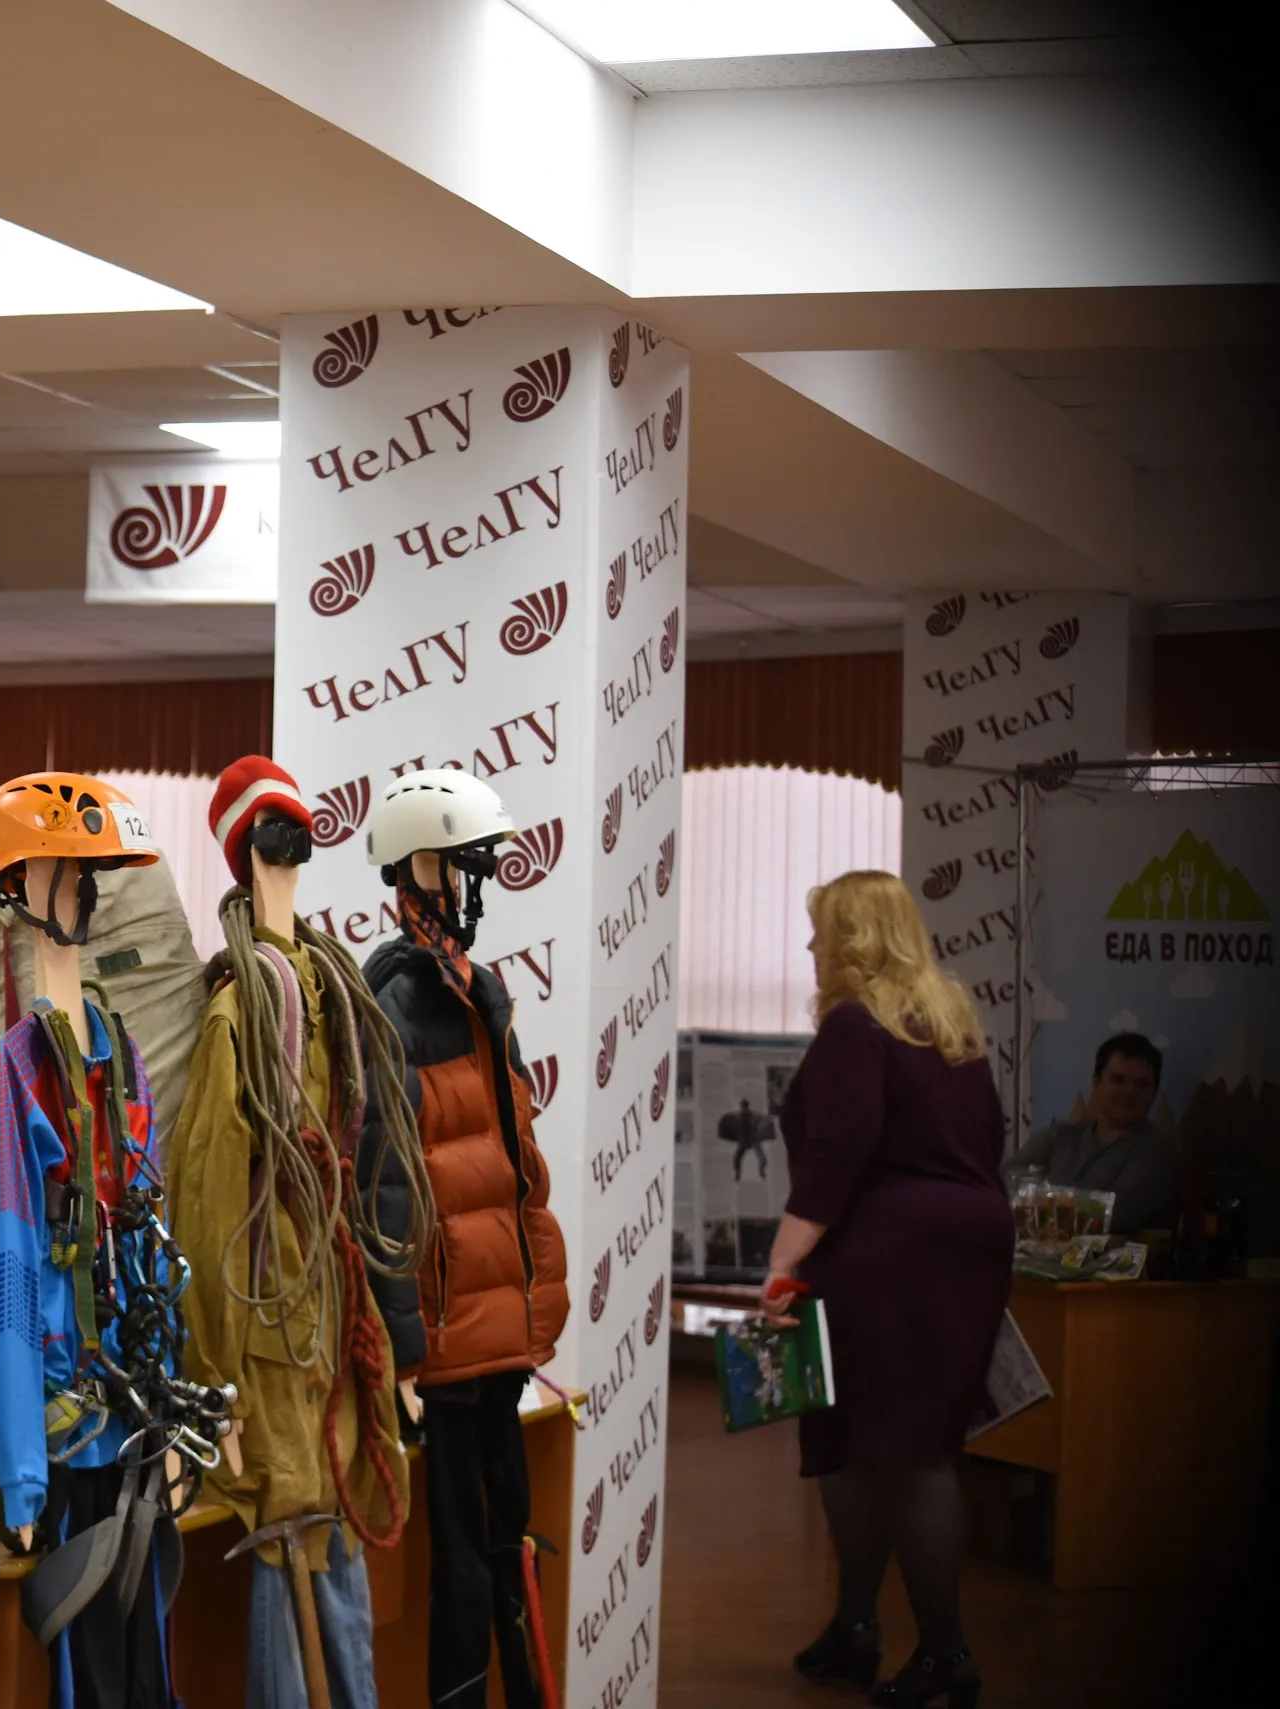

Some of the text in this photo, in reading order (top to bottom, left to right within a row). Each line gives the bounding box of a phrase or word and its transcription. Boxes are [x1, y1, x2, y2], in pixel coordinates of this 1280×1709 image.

[402, 306, 504, 340] Че
[635, 322, 665, 356] Че
[306, 387, 474, 493] ЧелГУ
[605, 412, 655, 495] ЧелГУ
[393, 465, 564, 570] ЧелГУ
[631, 498, 680, 582] ЧелГУ
[301, 620, 471, 724] ЧелГУ
[602, 637, 653, 726] ЧелГУ
[922, 639, 1023, 697] ЧелГУ
[975, 684, 1076, 742] ЧелГУ
[627, 720, 677, 810] ЧелГУ
[598, 864, 649, 960] ЧелГУ
[1105, 931, 1274, 967] ЕДА В ПОХОД
[622, 943, 671, 1039] ЧелГУ
[591, 1091, 643, 1194] ЧелГУ
[615, 1165, 666, 1269] ЧелГУ
[585, 1317, 637, 1429] ЧелГУ
[609, 1385, 660, 1495] ЧелГУ
[576, 1541, 629, 1659] ЧелГУ
